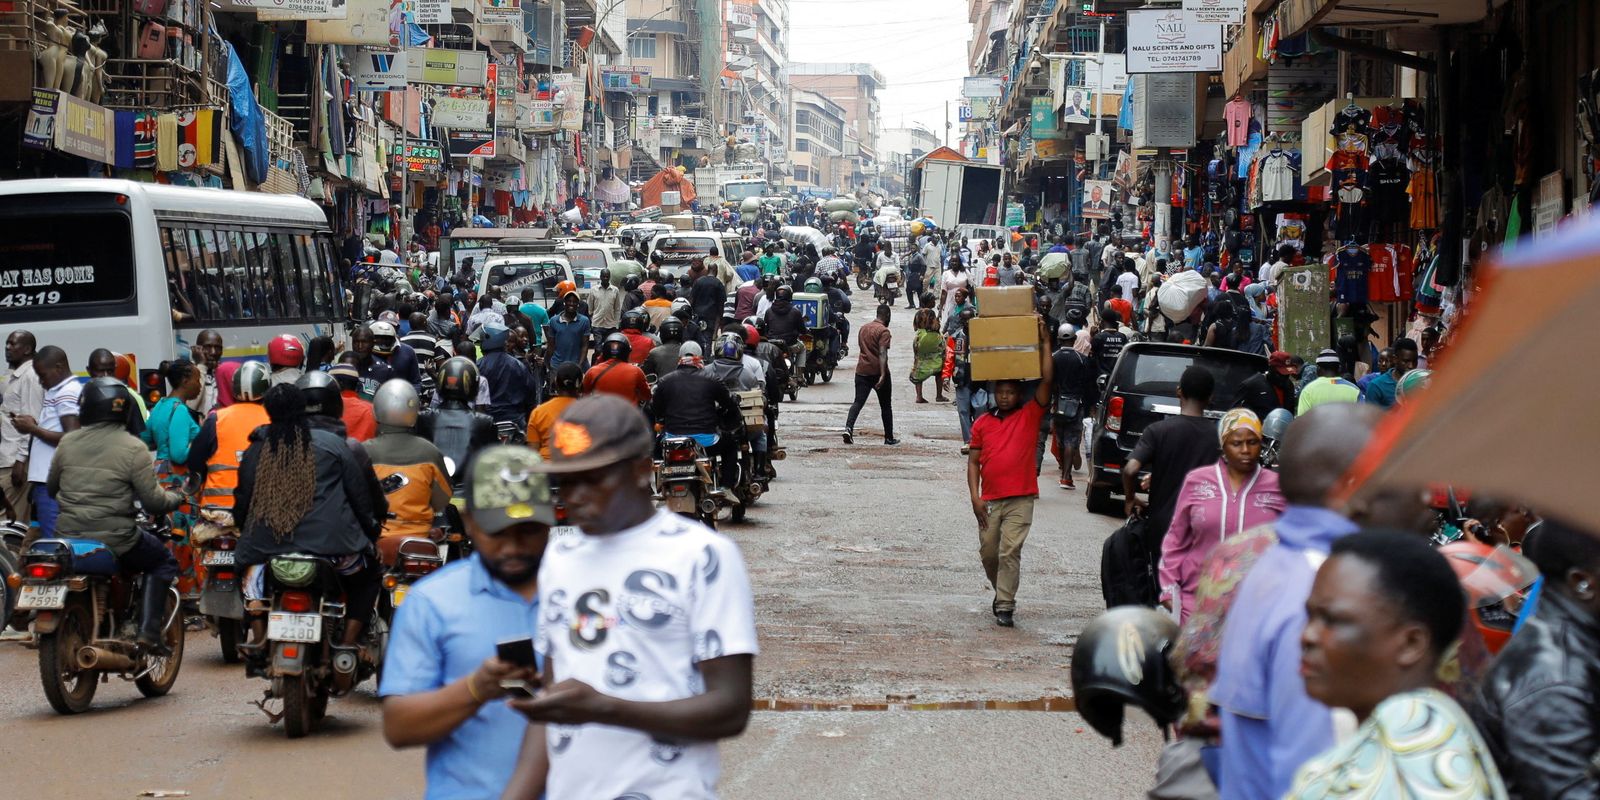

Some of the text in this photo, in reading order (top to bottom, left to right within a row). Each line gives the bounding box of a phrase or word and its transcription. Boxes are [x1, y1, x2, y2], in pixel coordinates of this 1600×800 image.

[1155, 23, 1187, 33] NALU
[960, 107, 972, 118] 18
[0, 265, 95, 288] AY HAS COME
[0, 290, 61, 308] 43:19
